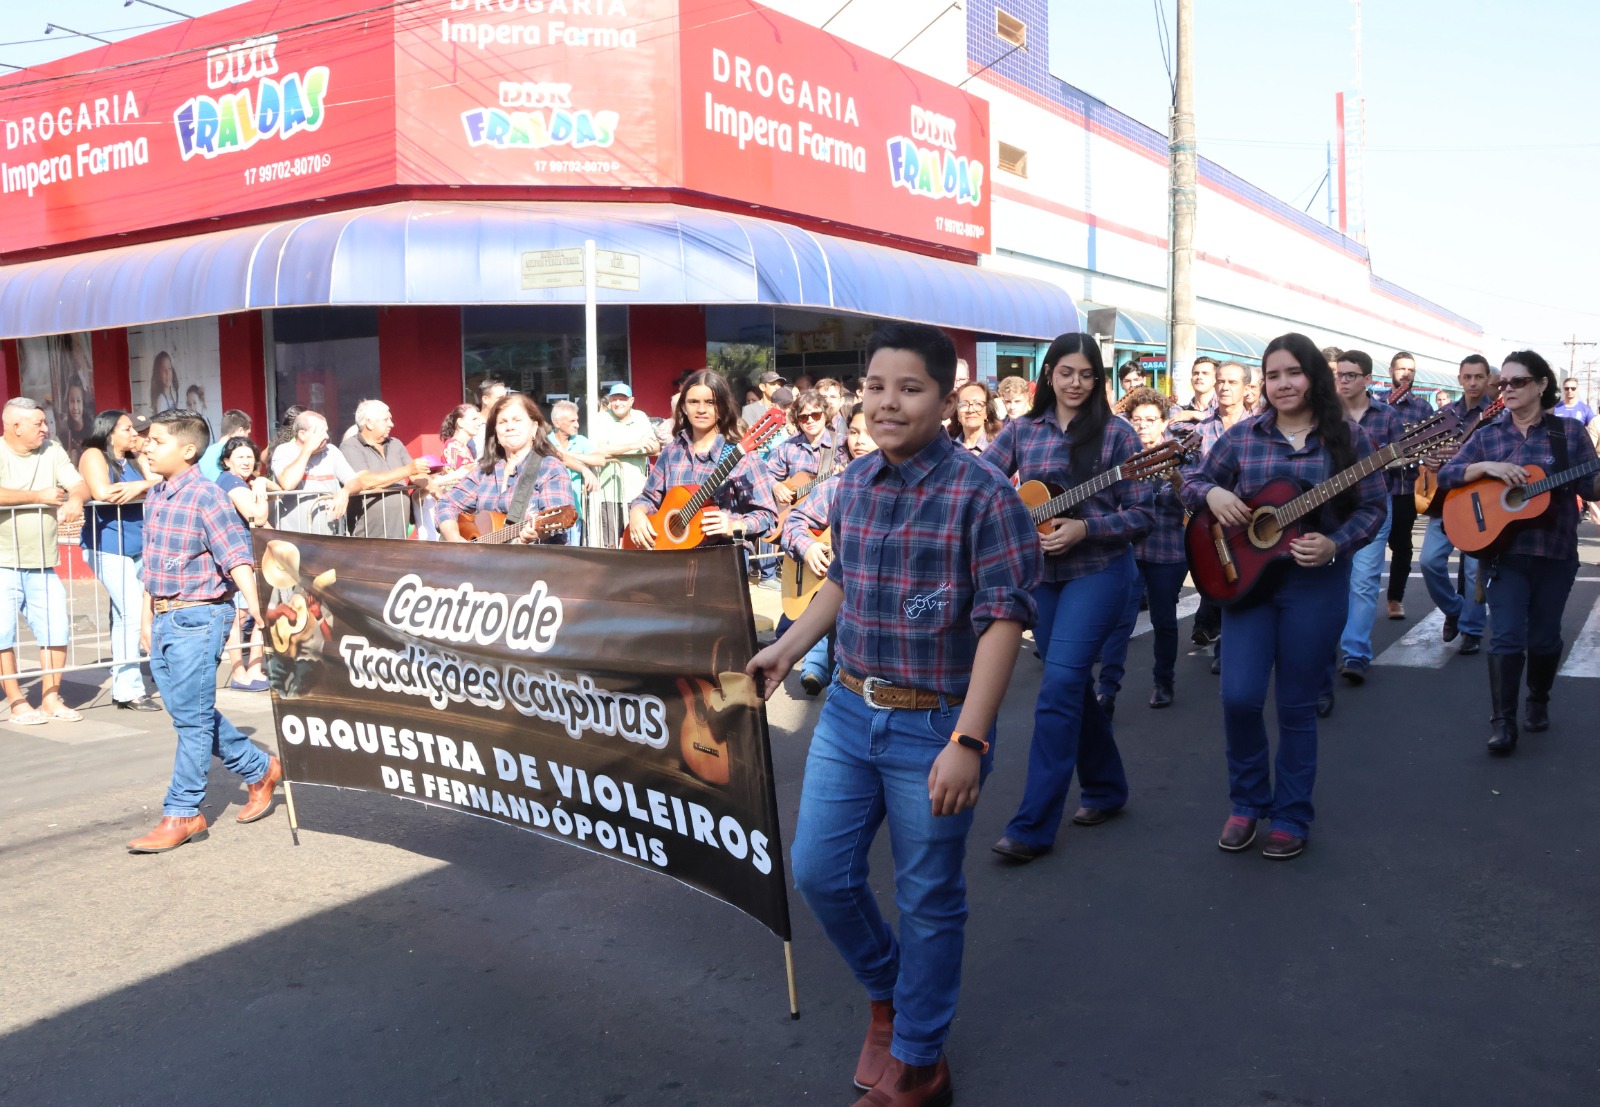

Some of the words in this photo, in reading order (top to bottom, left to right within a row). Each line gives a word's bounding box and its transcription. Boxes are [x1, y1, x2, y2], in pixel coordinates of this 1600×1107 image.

[441, 18, 540, 49] Impera
[548, 21, 636, 48] Farma
[6, 91, 139, 149] DROGARIA
[174, 67, 330, 161] FRALDAS
[713, 48, 860, 127] DROGARIA
[461, 108, 619, 148] FRALDAS
[705, 92, 792, 150] Impera
[799, 121, 866, 173] Farma
[2, 155, 72, 197] Impera
[77, 137, 148, 177] Farma
[244, 168, 256, 185] 17
[259, 156, 321, 183] 99702-8070
[534, 160, 547, 172] 17
[887, 136, 983, 206] FRALDAS
[386, 578, 505, 642] Centro
[509, 585, 560, 648] de
[341, 638, 503, 706] Tradições
[505, 664, 666, 745] Caipiras
[282, 715, 486, 775] ORQUESTRA
[493, 747, 541, 790] DE
[548, 761, 772, 875] VIOLEIROS
[381, 766, 416, 794] DE
[422, 773, 668, 867] FERNANDÓPOLIS
